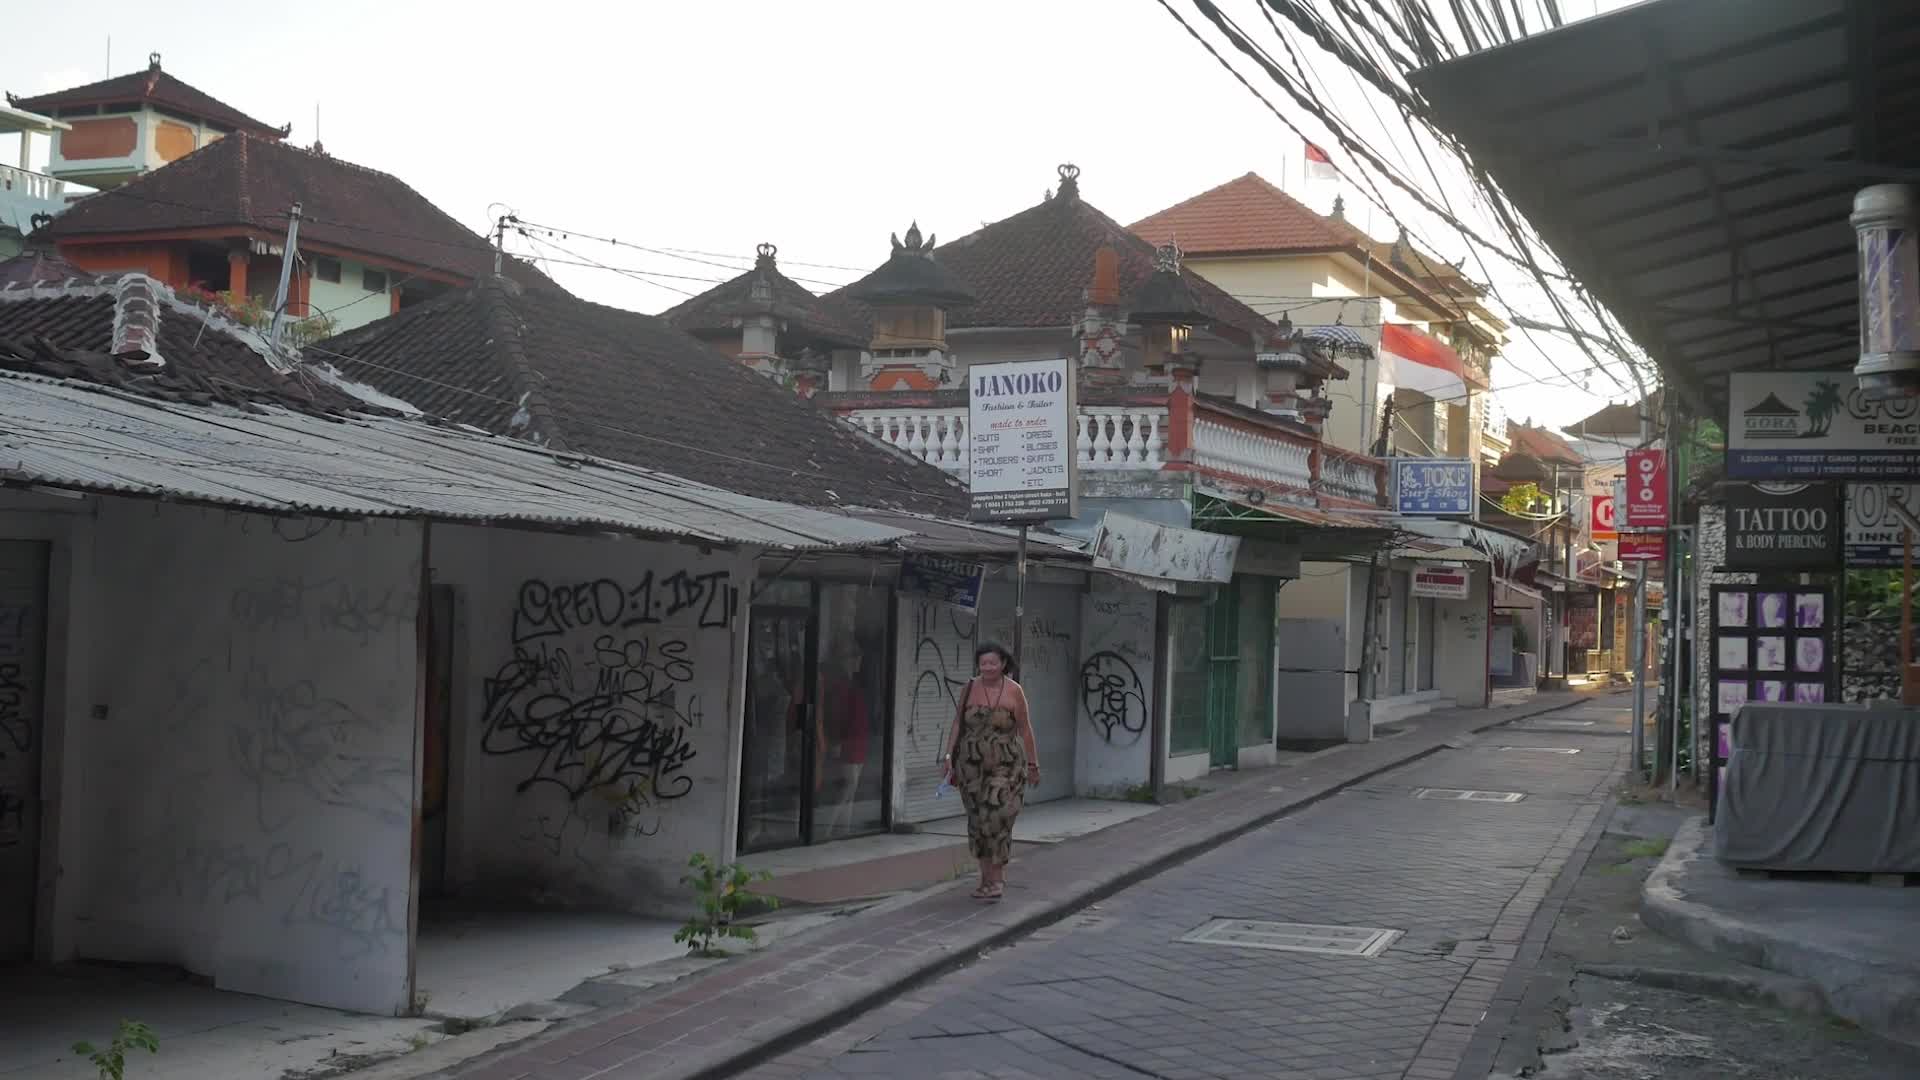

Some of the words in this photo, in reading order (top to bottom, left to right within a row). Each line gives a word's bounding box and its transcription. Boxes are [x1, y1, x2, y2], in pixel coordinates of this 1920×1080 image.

[975, 371, 1062, 397] JANOKO
[982, 402, 1015, 411] Fashion
[1017, 401, 1024, 409] &
[1027, 400, 1054, 408] Tailor
[990, 418, 1011, 429] made
[1015, 417, 1023, 427] to
[1026, 416, 1047, 426] order
[1745, 418, 1799, 429] GORA
[977, 433, 1000, 442] SUITS
[1026, 431, 1052, 439] DRESS
[977, 445, 1000, 454] SHIRT
[978, 456, 1019, 465] TROUSERS
[977, 469, 1003, 478] SHORT
[1026, 465, 1064, 475] JACKETS
[1026, 479, 1044, 487] ETC
[1640, 459, 1654, 501] OYO
[1401, 488, 1433, 502] Surf
[1736, 508, 1827, 531] TATTOO
[1736, 536, 1744, 548] &
[1747, 535, 1775, 548] BODY
[1778, 534, 1826, 548] PIERCING
